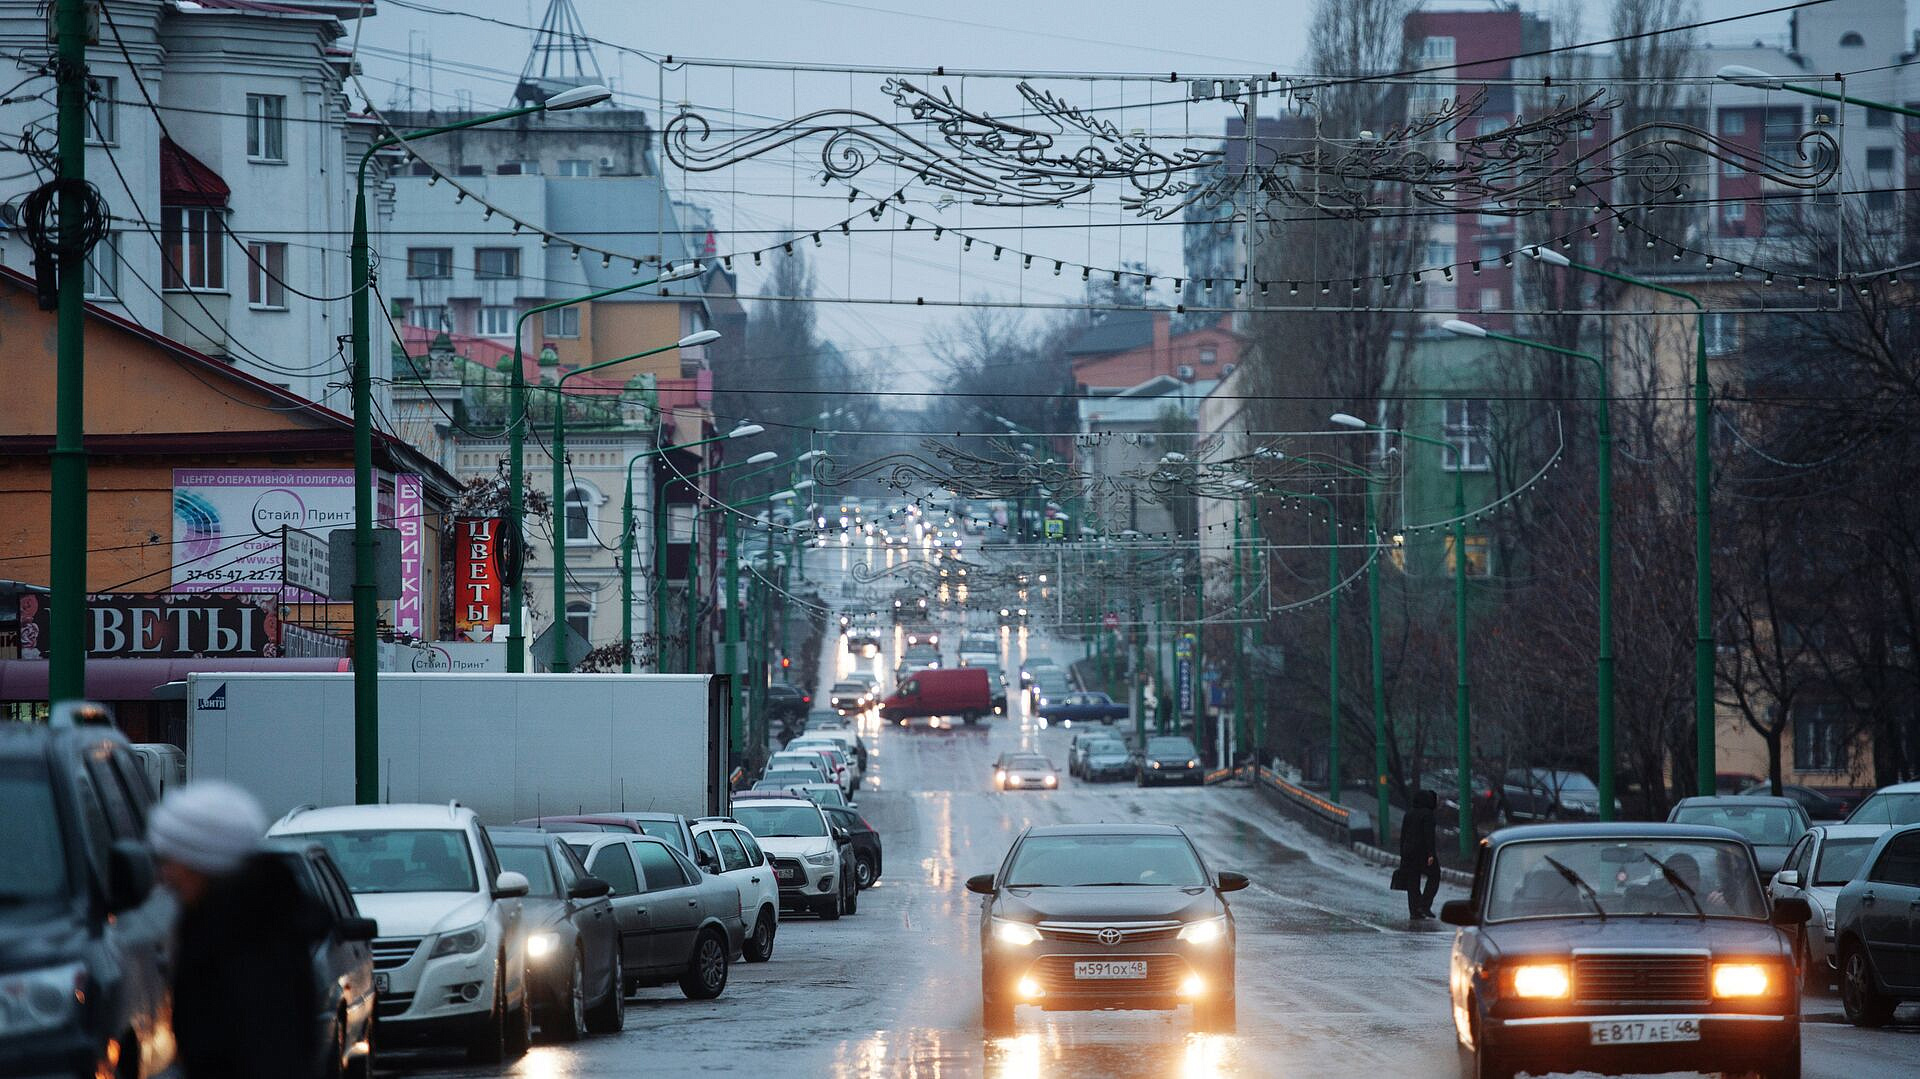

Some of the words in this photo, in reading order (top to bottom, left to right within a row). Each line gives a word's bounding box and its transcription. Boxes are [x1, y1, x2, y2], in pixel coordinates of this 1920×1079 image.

[182, 475, 215, 485] ЦЕНТР
[217, 473, 295, 485] ОПЕРАТИВНОЙ
[297, 475, 353, 485] ПОЛИГРАФ
[257, 509, 299, 520] Стайл
[308, 509, 350, 522] Принт
[243, 540, 282, 550] стайл-
[400, 484, 418, 611] ВИЗИТКИ
[235, 555, 283, 564] www.st
[187, 571, 244, 582] 37-65-47,
[250, 571, 283, 581] 22-72
[467, 520, 492, 621] ЦВЕТЫ
[44, 607, 257, 653] ВЕТЫ
[416, 660, 447, 669] Стайл
[453, 660, 485, 670] Принт
